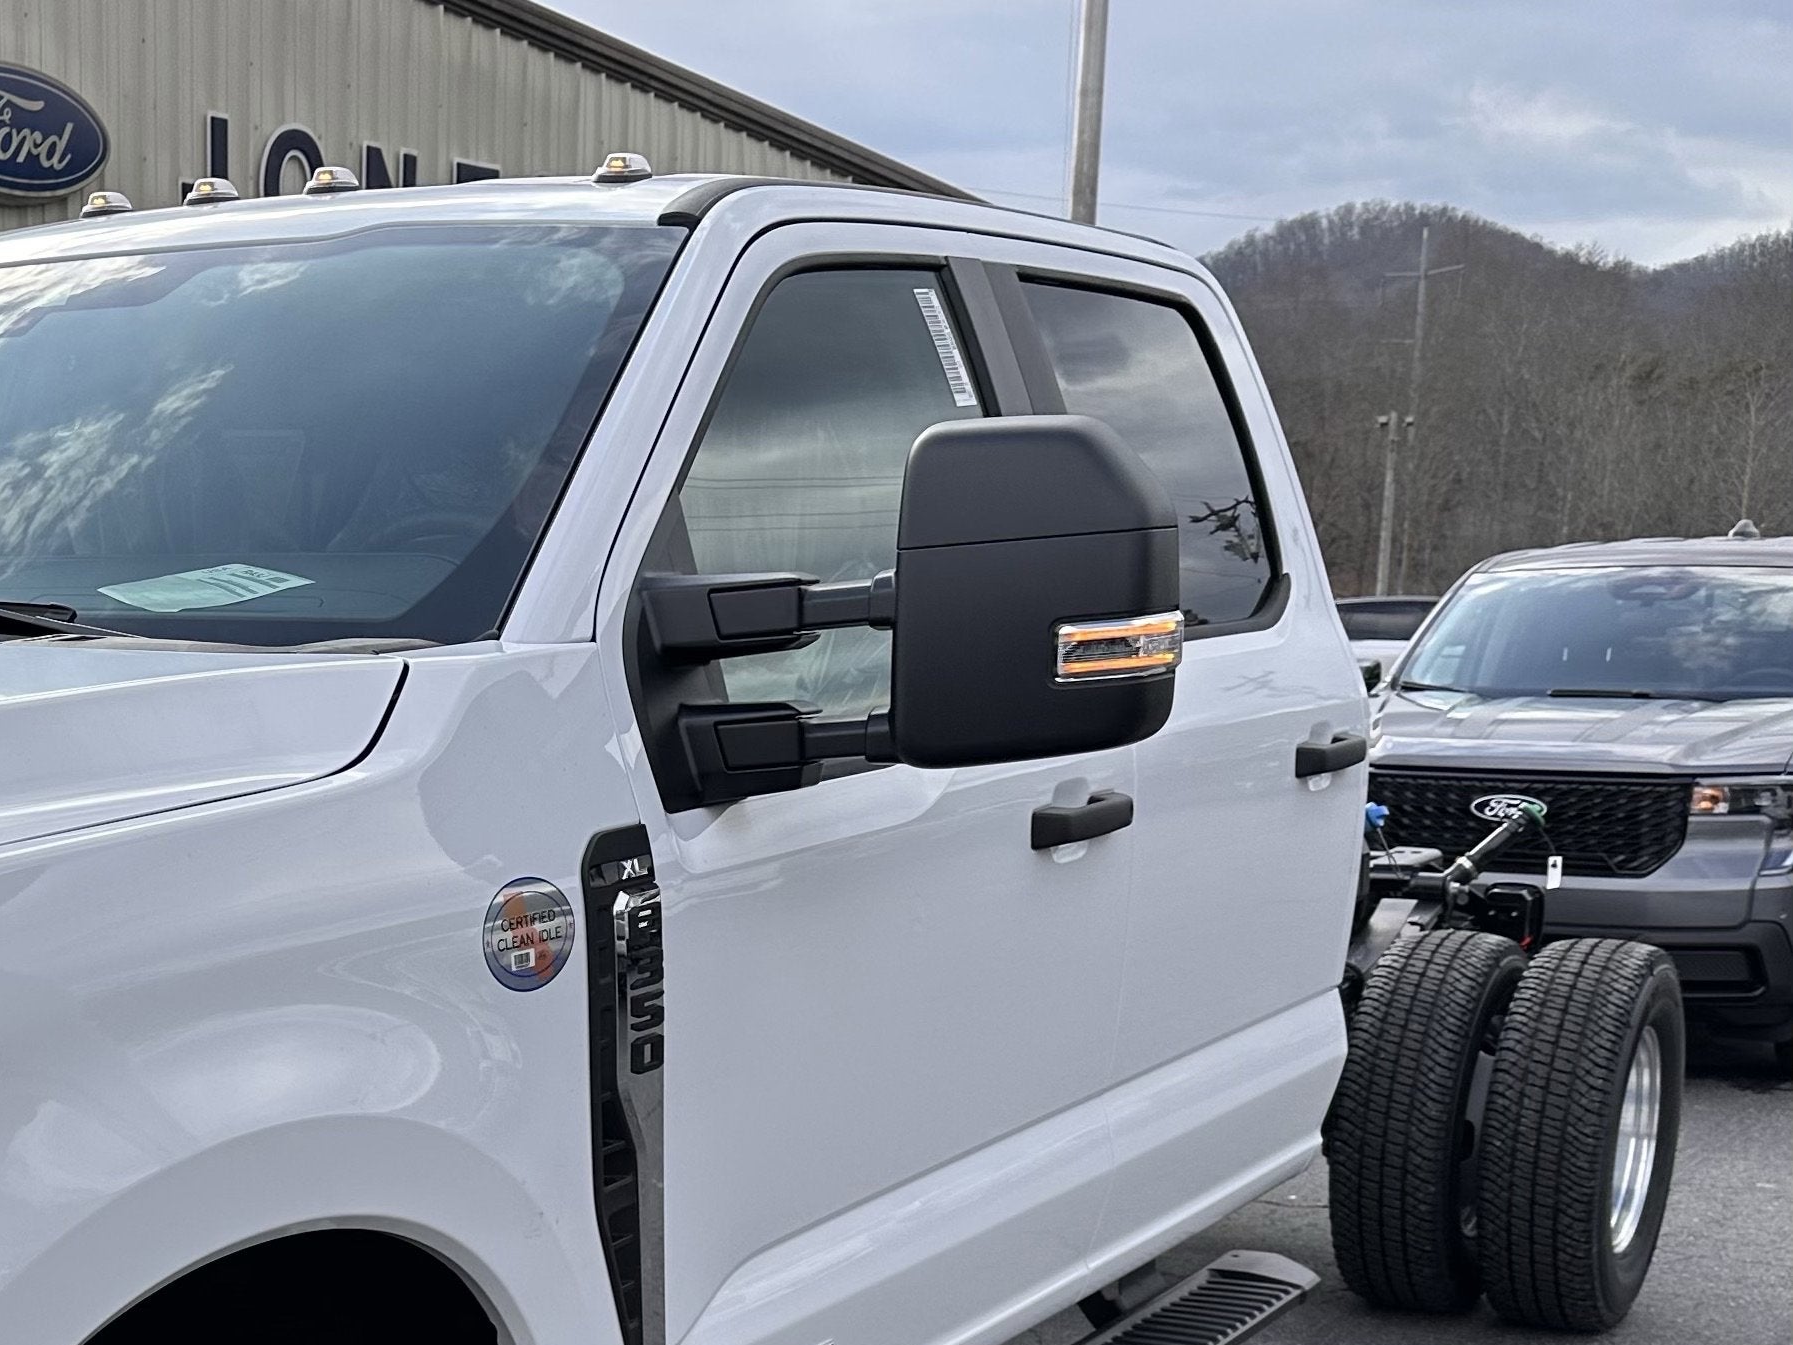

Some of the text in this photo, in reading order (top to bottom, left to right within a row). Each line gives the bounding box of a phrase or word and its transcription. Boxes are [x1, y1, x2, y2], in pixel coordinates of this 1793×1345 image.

[620, 858, 648, 880] XL
[501, 909, 556, 932] CERTIFIED
[497, 926, 562, 952] CLEAN IDLE
